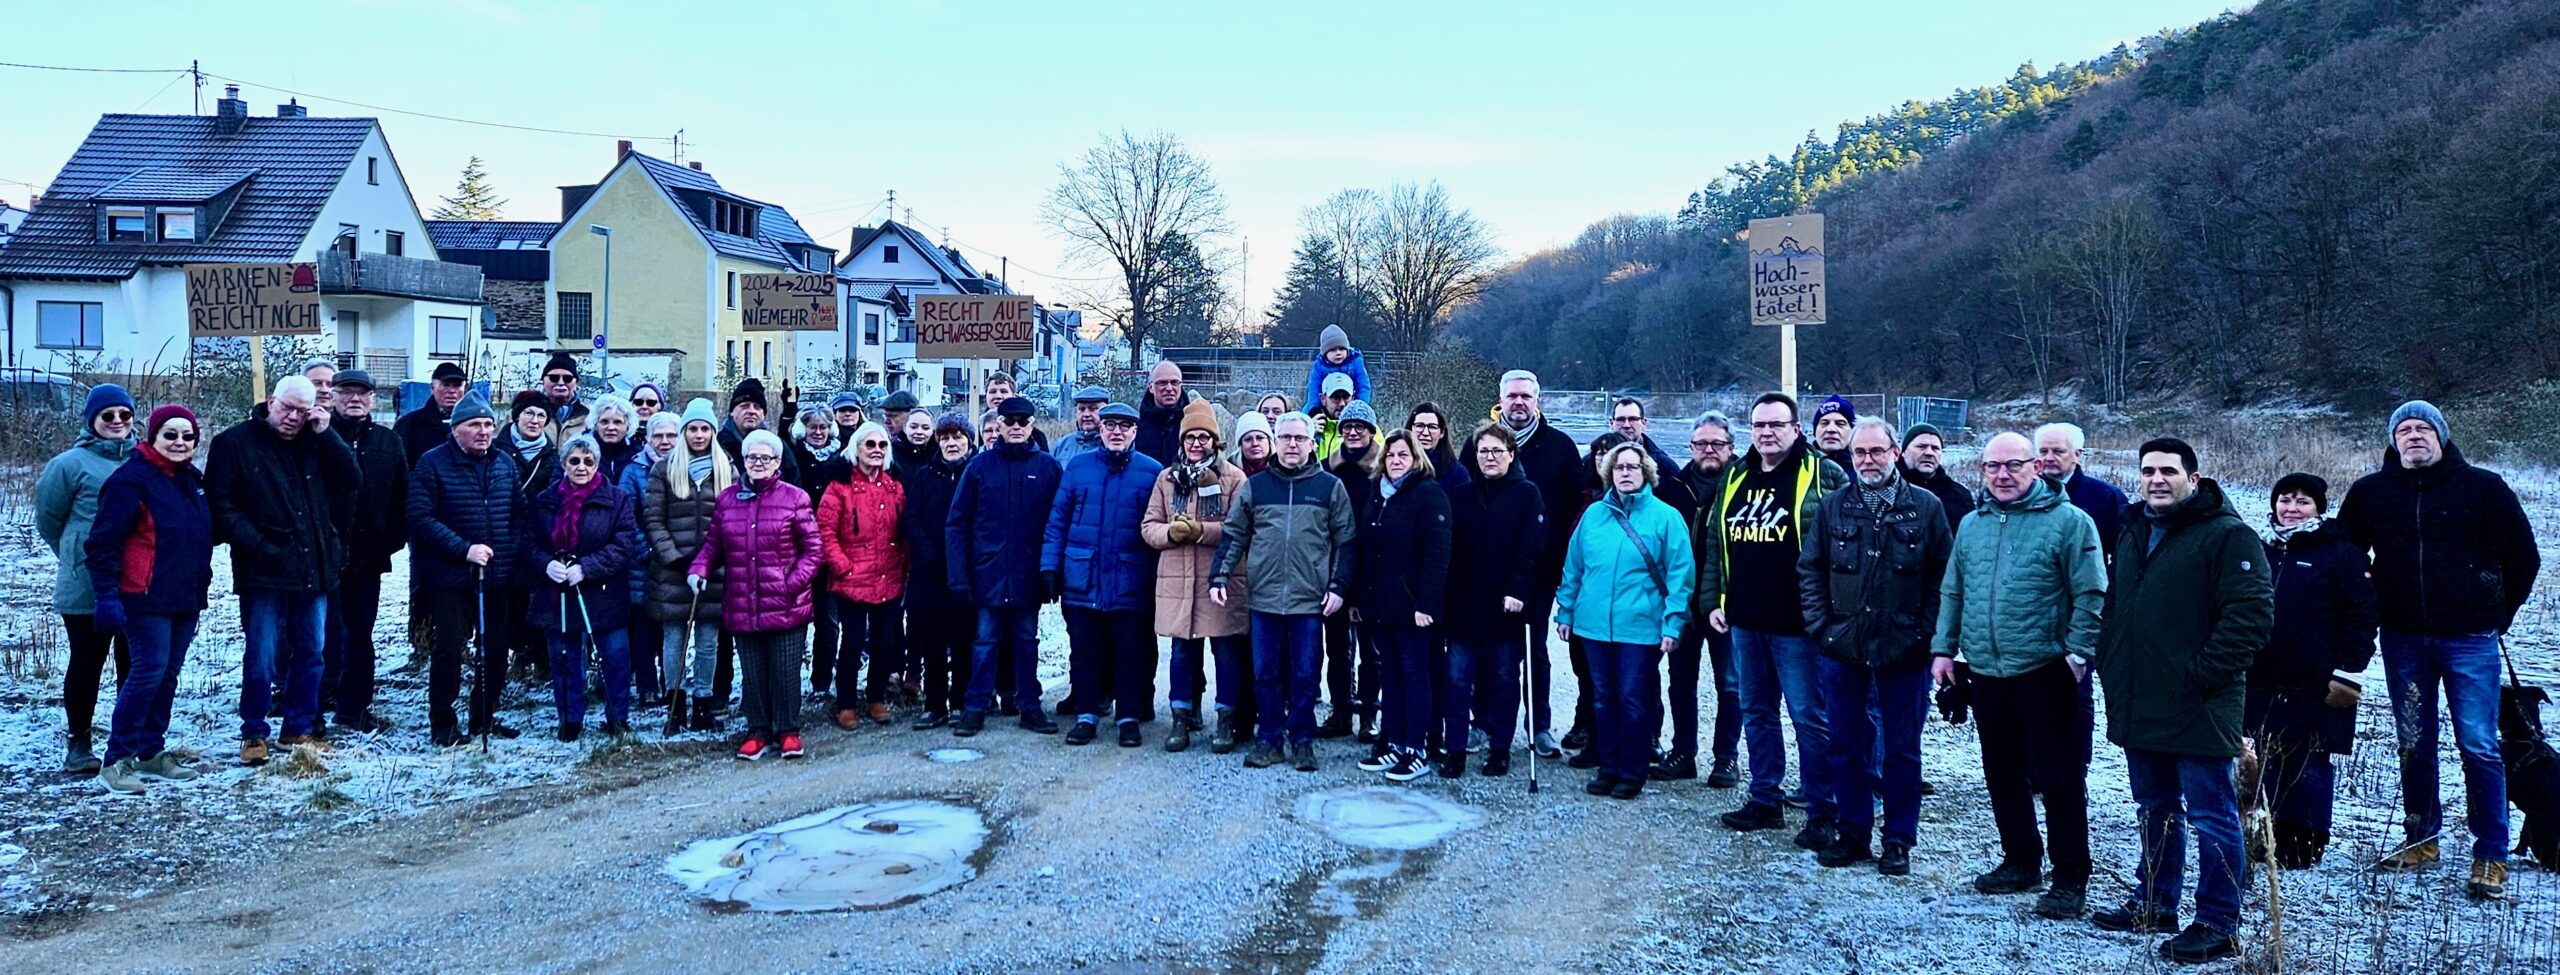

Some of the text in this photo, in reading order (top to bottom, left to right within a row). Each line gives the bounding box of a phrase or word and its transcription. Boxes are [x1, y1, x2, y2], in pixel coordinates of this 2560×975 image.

[189, 267, 281, 290] WARNEN
[742, 275, 834, 295] 2021 2025
[190, 287, 259, 307] ALLEIN
[1755, 283, 1821, 298] wasser
[191, 305, 268, 330] REICHT
[922, 300, 1029, 321] RECHT AUF
[1729, 525, 1788, 542] FAMILY
